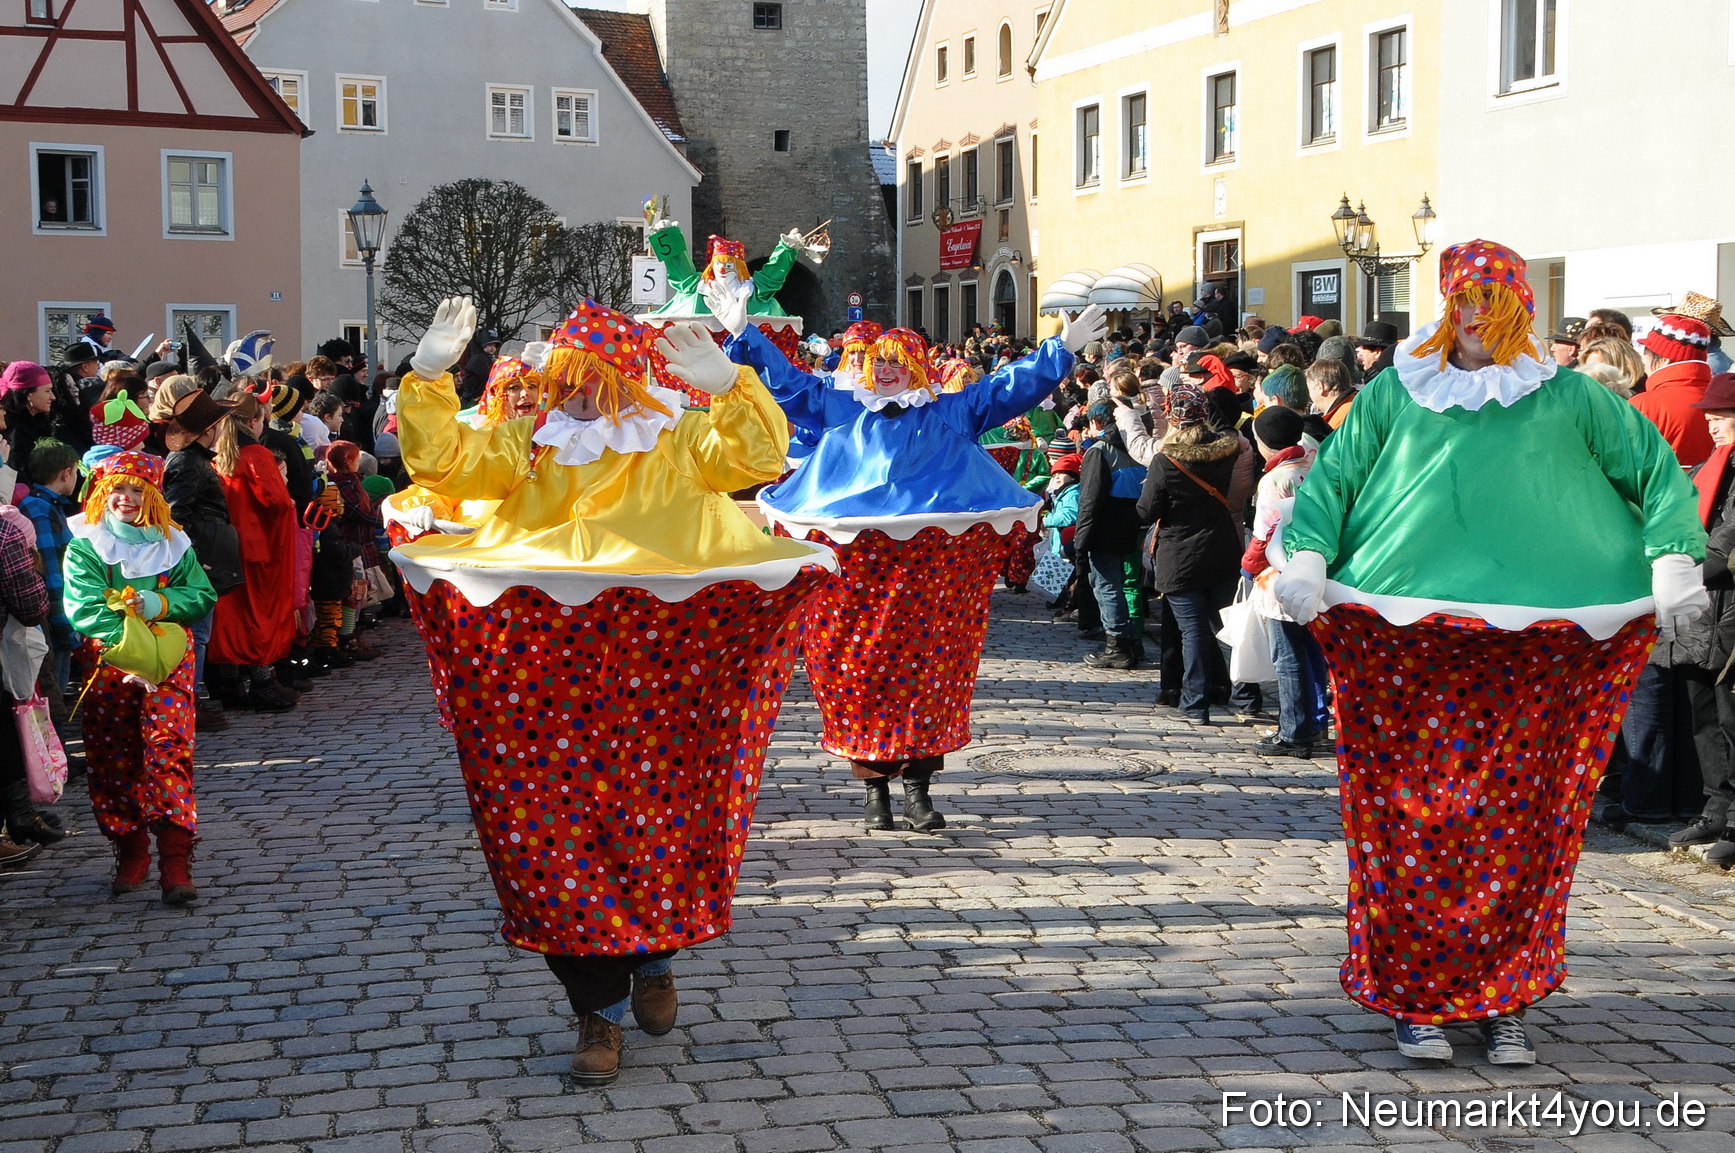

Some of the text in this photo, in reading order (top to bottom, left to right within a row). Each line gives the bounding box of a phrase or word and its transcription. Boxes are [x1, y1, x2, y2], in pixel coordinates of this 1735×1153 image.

[657, 233, 672, 256] 5
[642, 268, 656, 293] 5
[1314, 276, 1336, 292] BW
